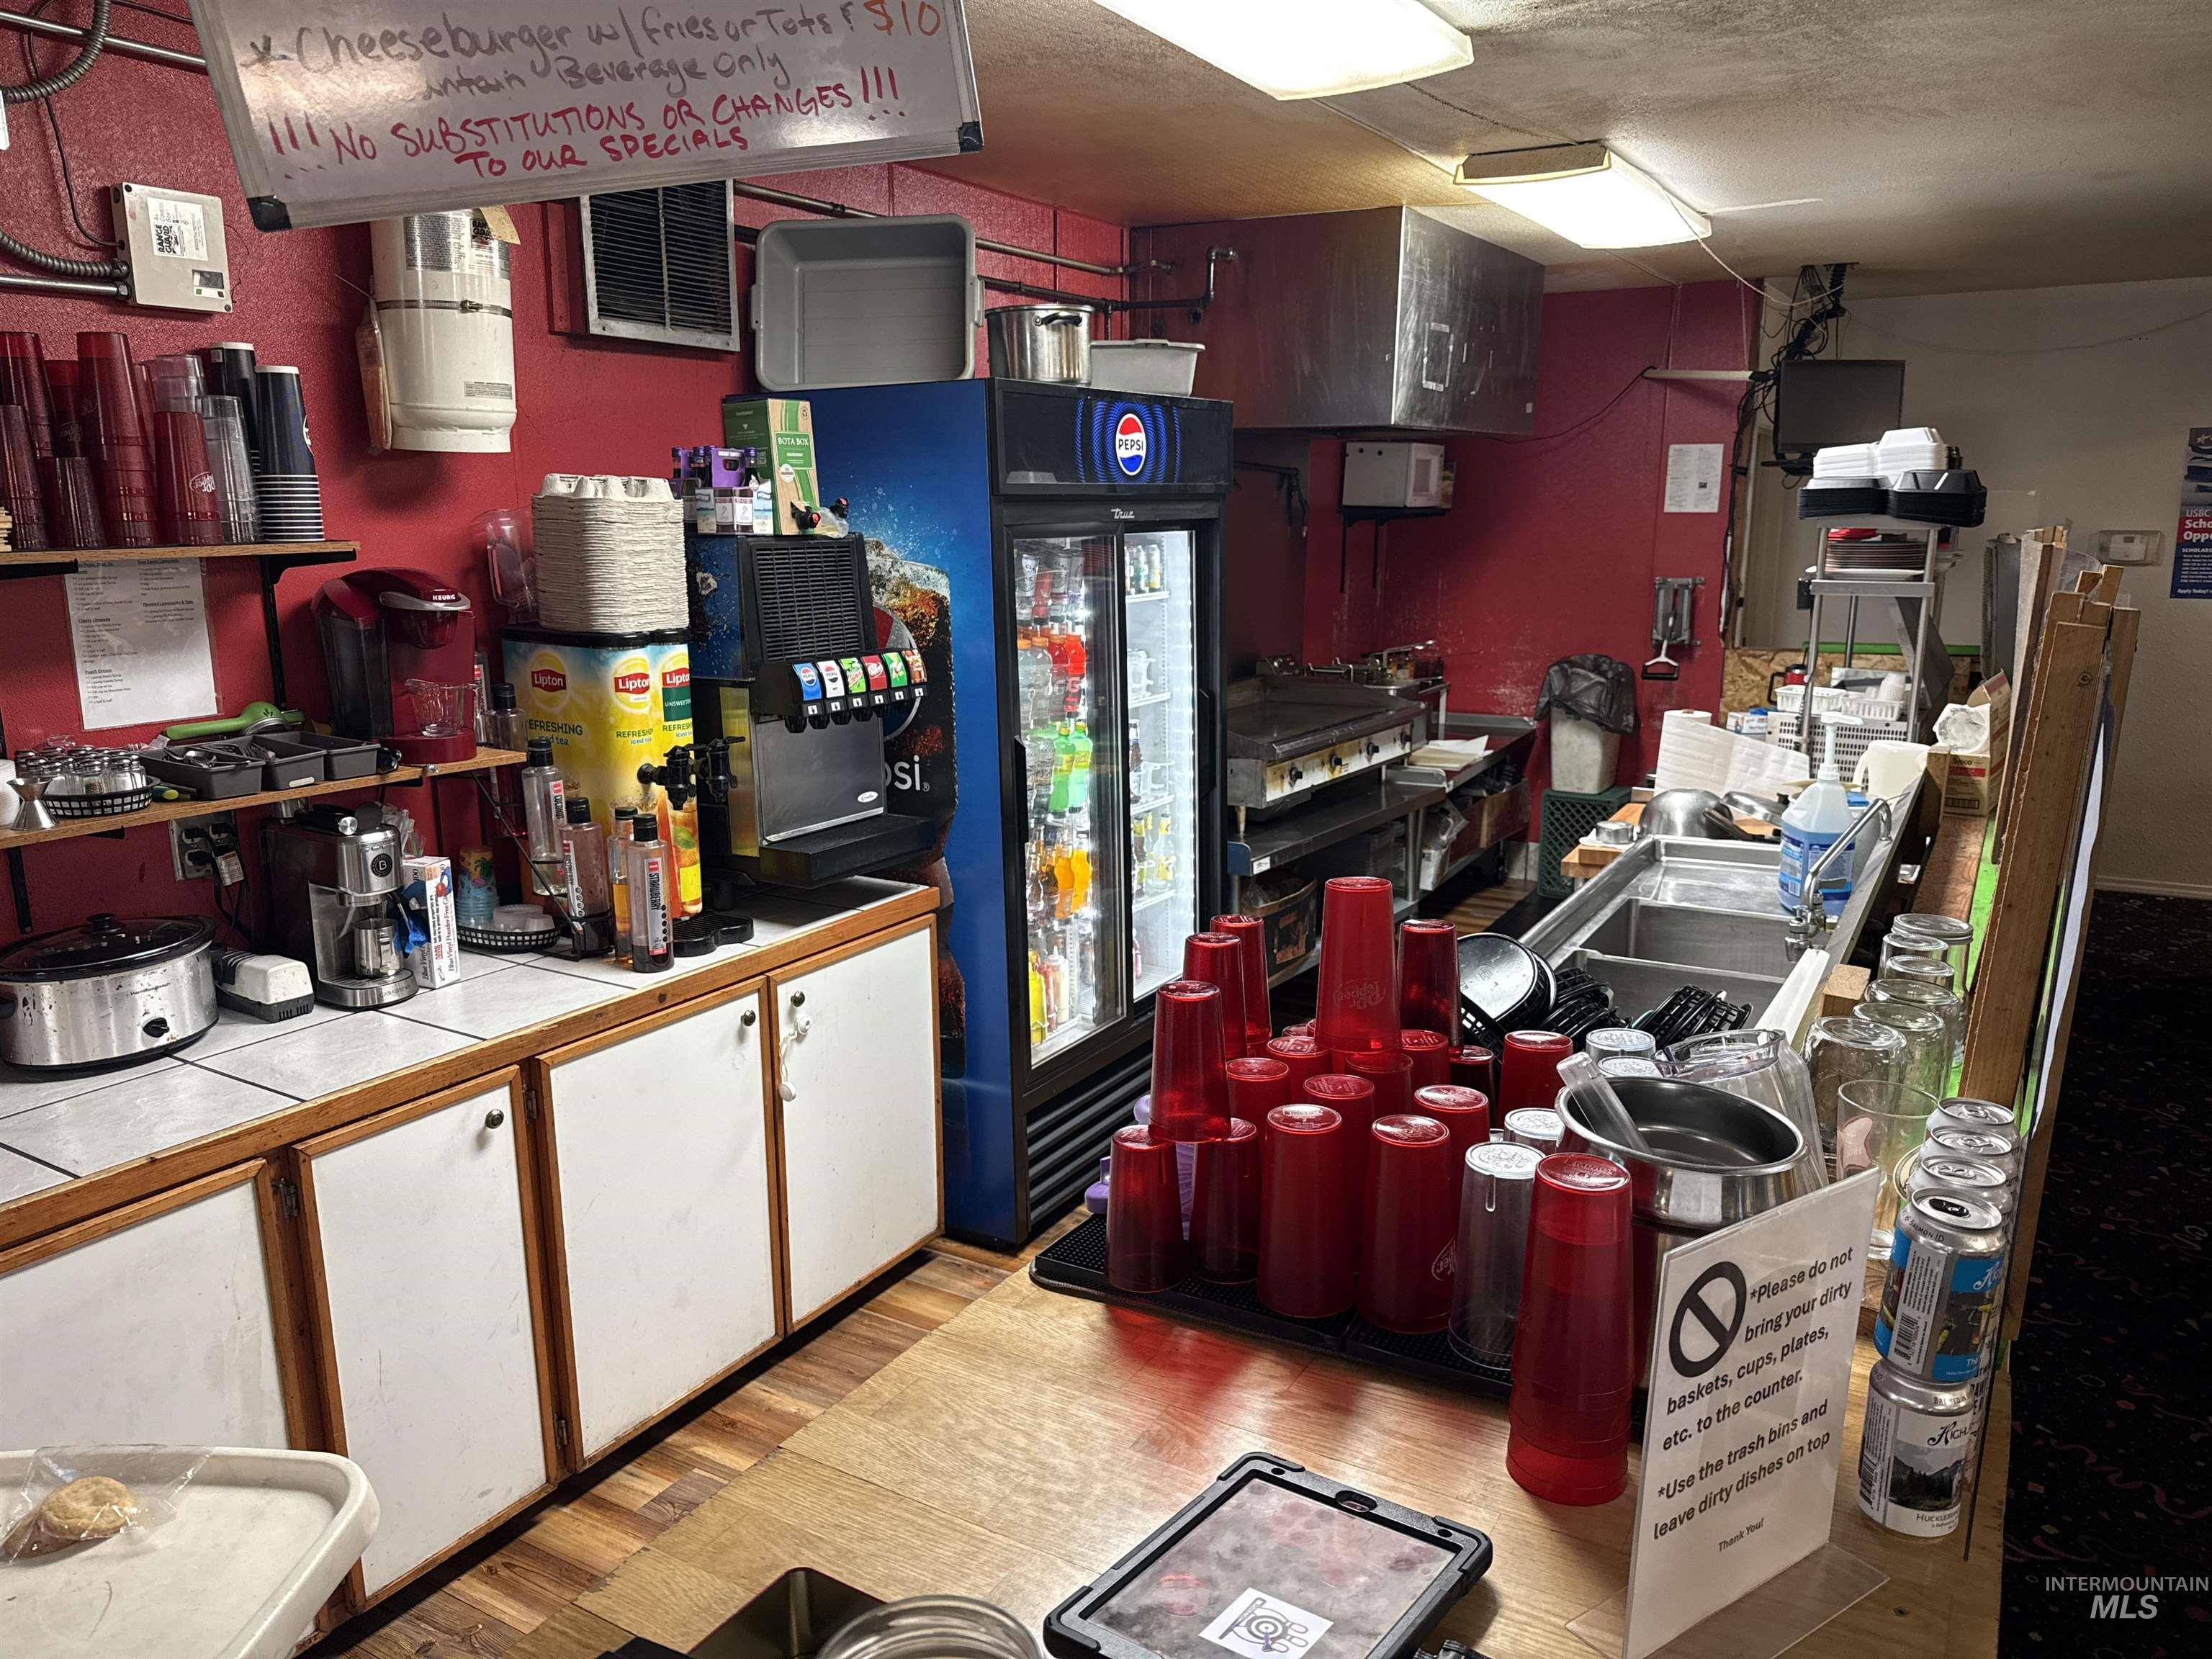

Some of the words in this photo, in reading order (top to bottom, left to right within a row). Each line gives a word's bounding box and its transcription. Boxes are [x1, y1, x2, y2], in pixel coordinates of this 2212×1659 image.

[295, 12, 571, 76] Cheeseburger
[726, 19, 756, 42] or
[863, 0, 942, 36] $10
[555, 55, 707, 98] Beverage
[390, 102, 645, 158] SUBSTITUTIONS
[663, 99, 706, 130] OR
[712, 84, 853, 126] CHANGES
[523, 144, 587, 171] OUR
[599, 126, 749, 161] SPECIALS
[156, 224, 165, 253] RANGE
[163, 225, 172, 253] GUARD
[778, 437, 796, 446] BOTA
[796, 437, 809, 446] BOX
[1118, 438, 1144, 451] PEPSI
[1111, 508, 1136, 519] True
[2185, 508, 2211, 517] USBC
[2185, 518, 2212, 529] Scho
[534, 673, 564, 687] Lipton
[666, 673, 690, 685] Lipto
[529, 719, 583, 736] EFRESHING
[555, 737, 569, 745] tea
[1952, 757, 1973, 765] Sysco
[649, 872, 661, 911] STRAWBERRY
[1909, 1220, 1934, 1238] SALMON
[1809, 1259, 1827, 1279] do
[1830, 1246, 1853, 1270] not
[1745, 1313, 1781, 1343] bring
[1786, 1297, 1817, 1327] your
[1820, 1281, 1852, 1307] dirty
[1667, 1374, 1733, 1415] baskets,
[1737, 1352, 1776, 1380] cups,
[1781, 1326, 1829, 1362] plates,
[1663, 1427, 1692, 1451] etc.
[1696, 1416, 1712, 1433] to
[1716, 1403, 1740, 1424] the
[1744, 1370, 1803, 1408] counter.
[1699, 1458, 1723, 1480] the
[1727, 1434, 1765, 1465] trash
[1768, 1418, 1798, 1444] bins
[1801, 1399, 1827, 1425] and
[1653, 1506, 1695, 1539] leave
[1699, 1483, 1732, 1514] dirty
[1735, 1457, 1783, 1493] dishes
[1786, 1446, 1804, 1465] on
[1807, 1431, 1830, 1453] top
[1718, 1531, 1745, 1552] Thank
[1745, 1517, 1764, 1535] You!
